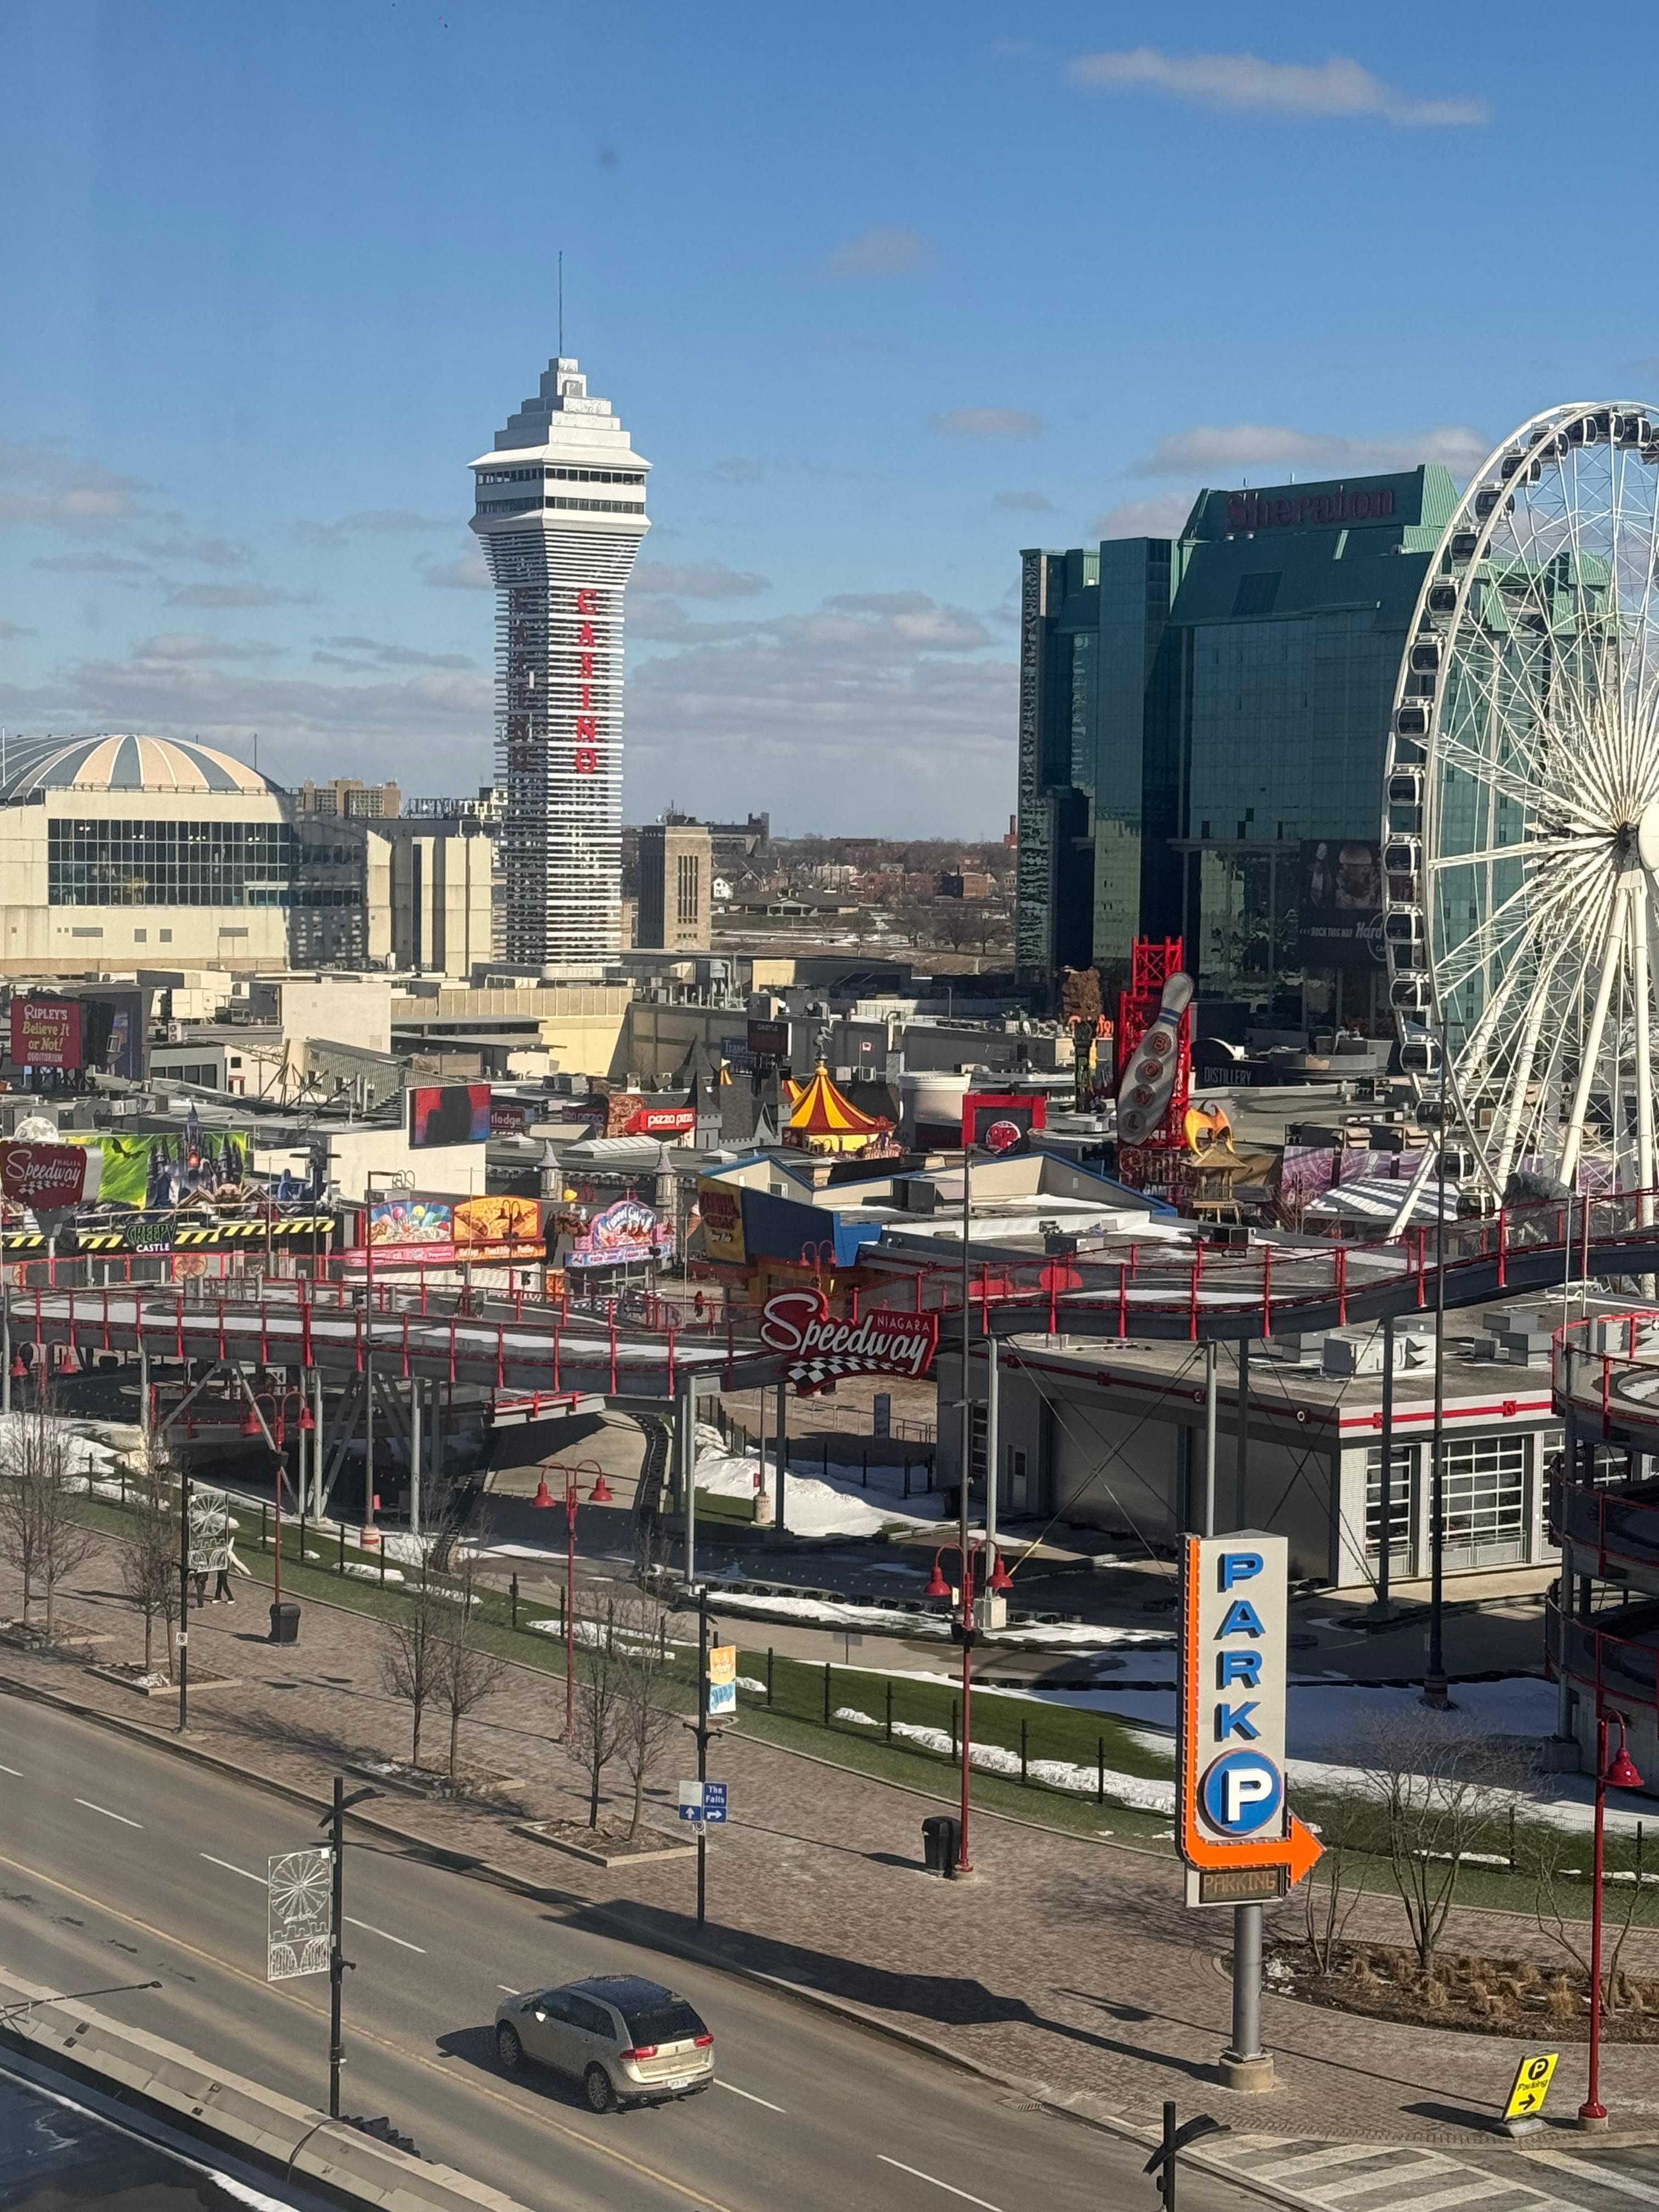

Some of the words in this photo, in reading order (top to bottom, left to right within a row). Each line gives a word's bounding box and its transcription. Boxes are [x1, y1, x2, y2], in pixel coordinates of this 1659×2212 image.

[1227, 490, 1393, 531] Sheraton
[575, 589, 597, 773] CASINO
[1355, 921, 1384, 939] Hard
[24, 1004, 68, 1020] RIPLEY'S
[22, 1021, 59, 1036] Believe
[59, 1023, 71, 1037] It
[28, 1040, 40, 1050] or
[41, 1037, 64, 1051] Not!
[1127, 1036, 1167, 1131] BOWL
[1204, 1066, 1252, 1085] DISTILLERY
[647, 1114, 675, 1128] pizza
[5, 1149, 82, 1189] Speedway
[126, 1222, 176, 1246] CREEPY
[136, 1242, 171, 1253] CASTLE
[761, 1292, 929, 1375] Speedway
[877, 1316, 930, 1333] NIAGARA
[1215, 1551, 1266, 1741] PARK
[705, 1795, 725, 1804] Falls
[1224, 1768, 1273, 1822] P
[1203, 1871, 1277, 1894] PARKING
[1516, 2079, 1549, 2092] Parking
